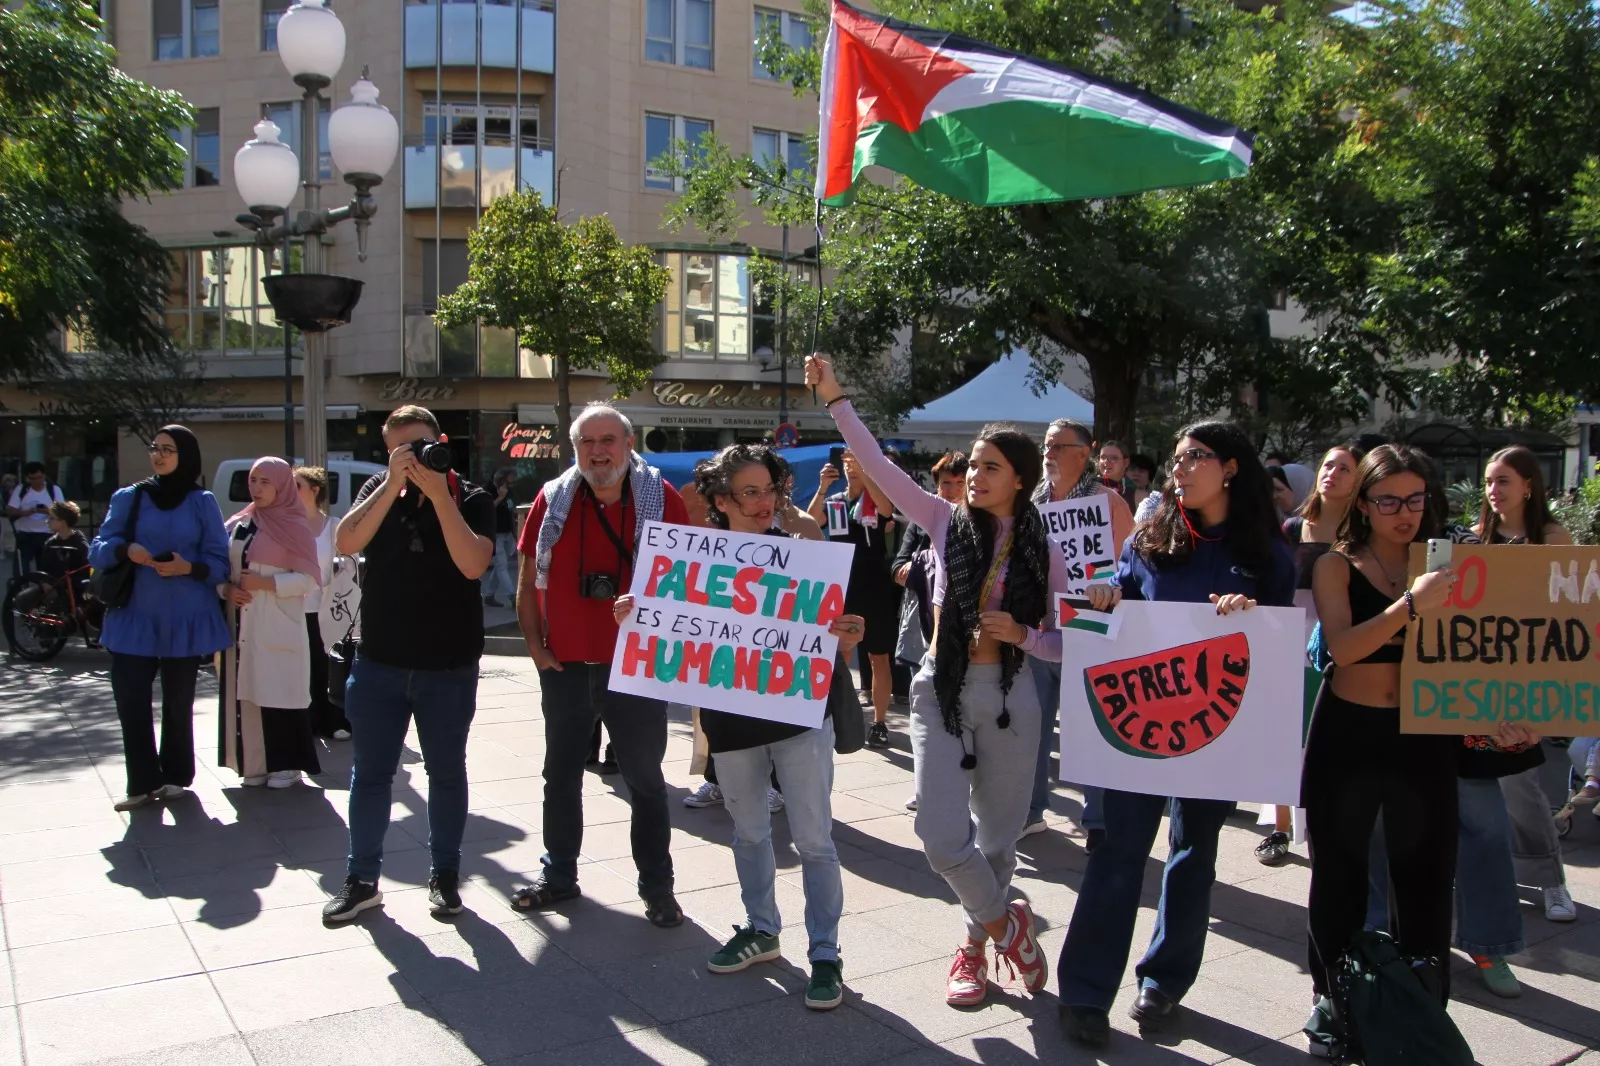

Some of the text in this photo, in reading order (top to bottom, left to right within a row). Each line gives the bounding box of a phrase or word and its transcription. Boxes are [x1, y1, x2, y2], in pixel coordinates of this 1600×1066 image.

[379, 377, 455, 401] Bar
[501, 422, 552, 452] Granja
[660, 416, 713, 425] RESTAURANTE
[647, 526, 791, 570] ESTAR CON
[1083, 533, 1104, 556] DE
[1442, 555, 1487, 609] O
[636, 607, 823, 654] ES ESTAR CON LA
[1416, 614, 1590, 665] LIBERTAD
[1094, 653, 1249, 752] PALESTINE
[1121, 656, 1192, 705] FREE
